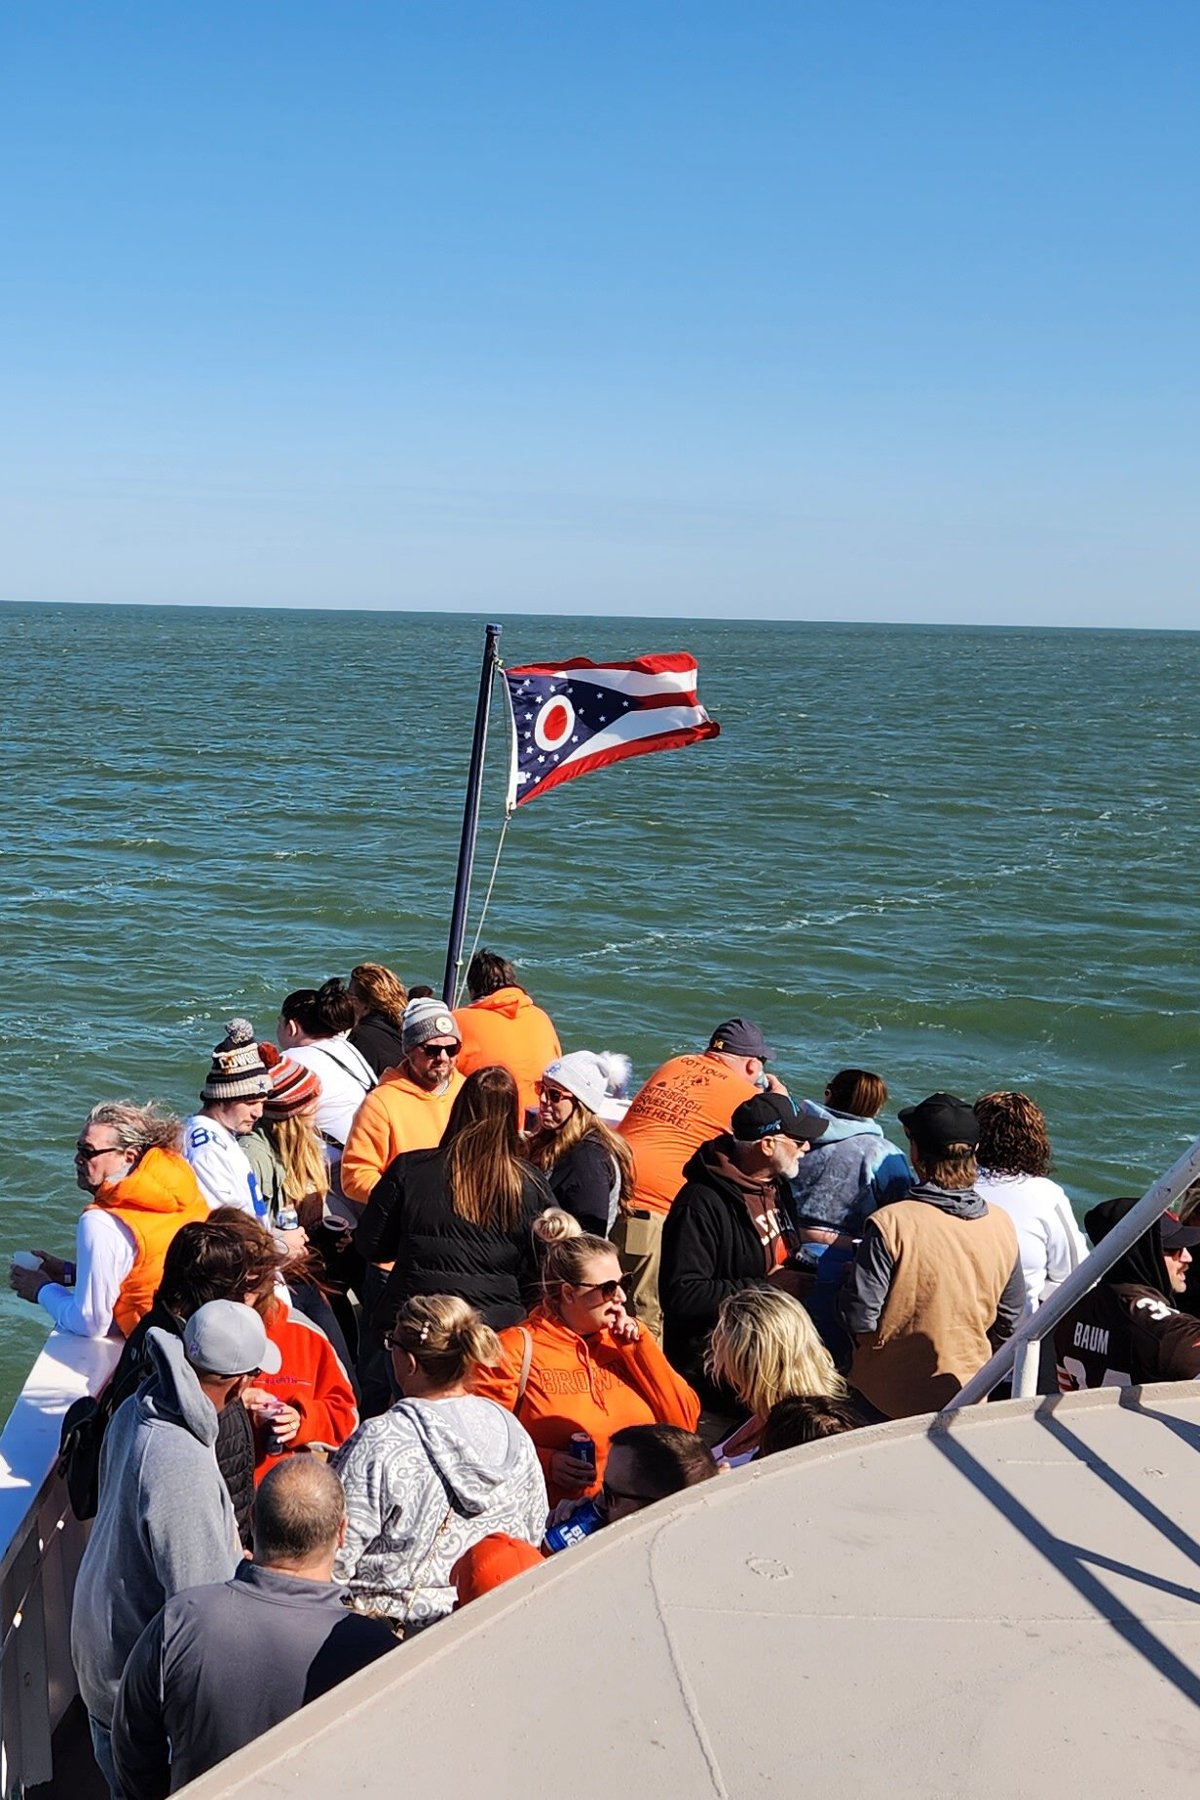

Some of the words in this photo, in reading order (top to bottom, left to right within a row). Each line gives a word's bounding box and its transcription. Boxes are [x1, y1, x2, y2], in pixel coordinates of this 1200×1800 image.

[680, 1057, 701, 1069] GOT
[699, 1065, 729, 1081] YOUR
[1073, 1321, 1110, 1356] BAUM
